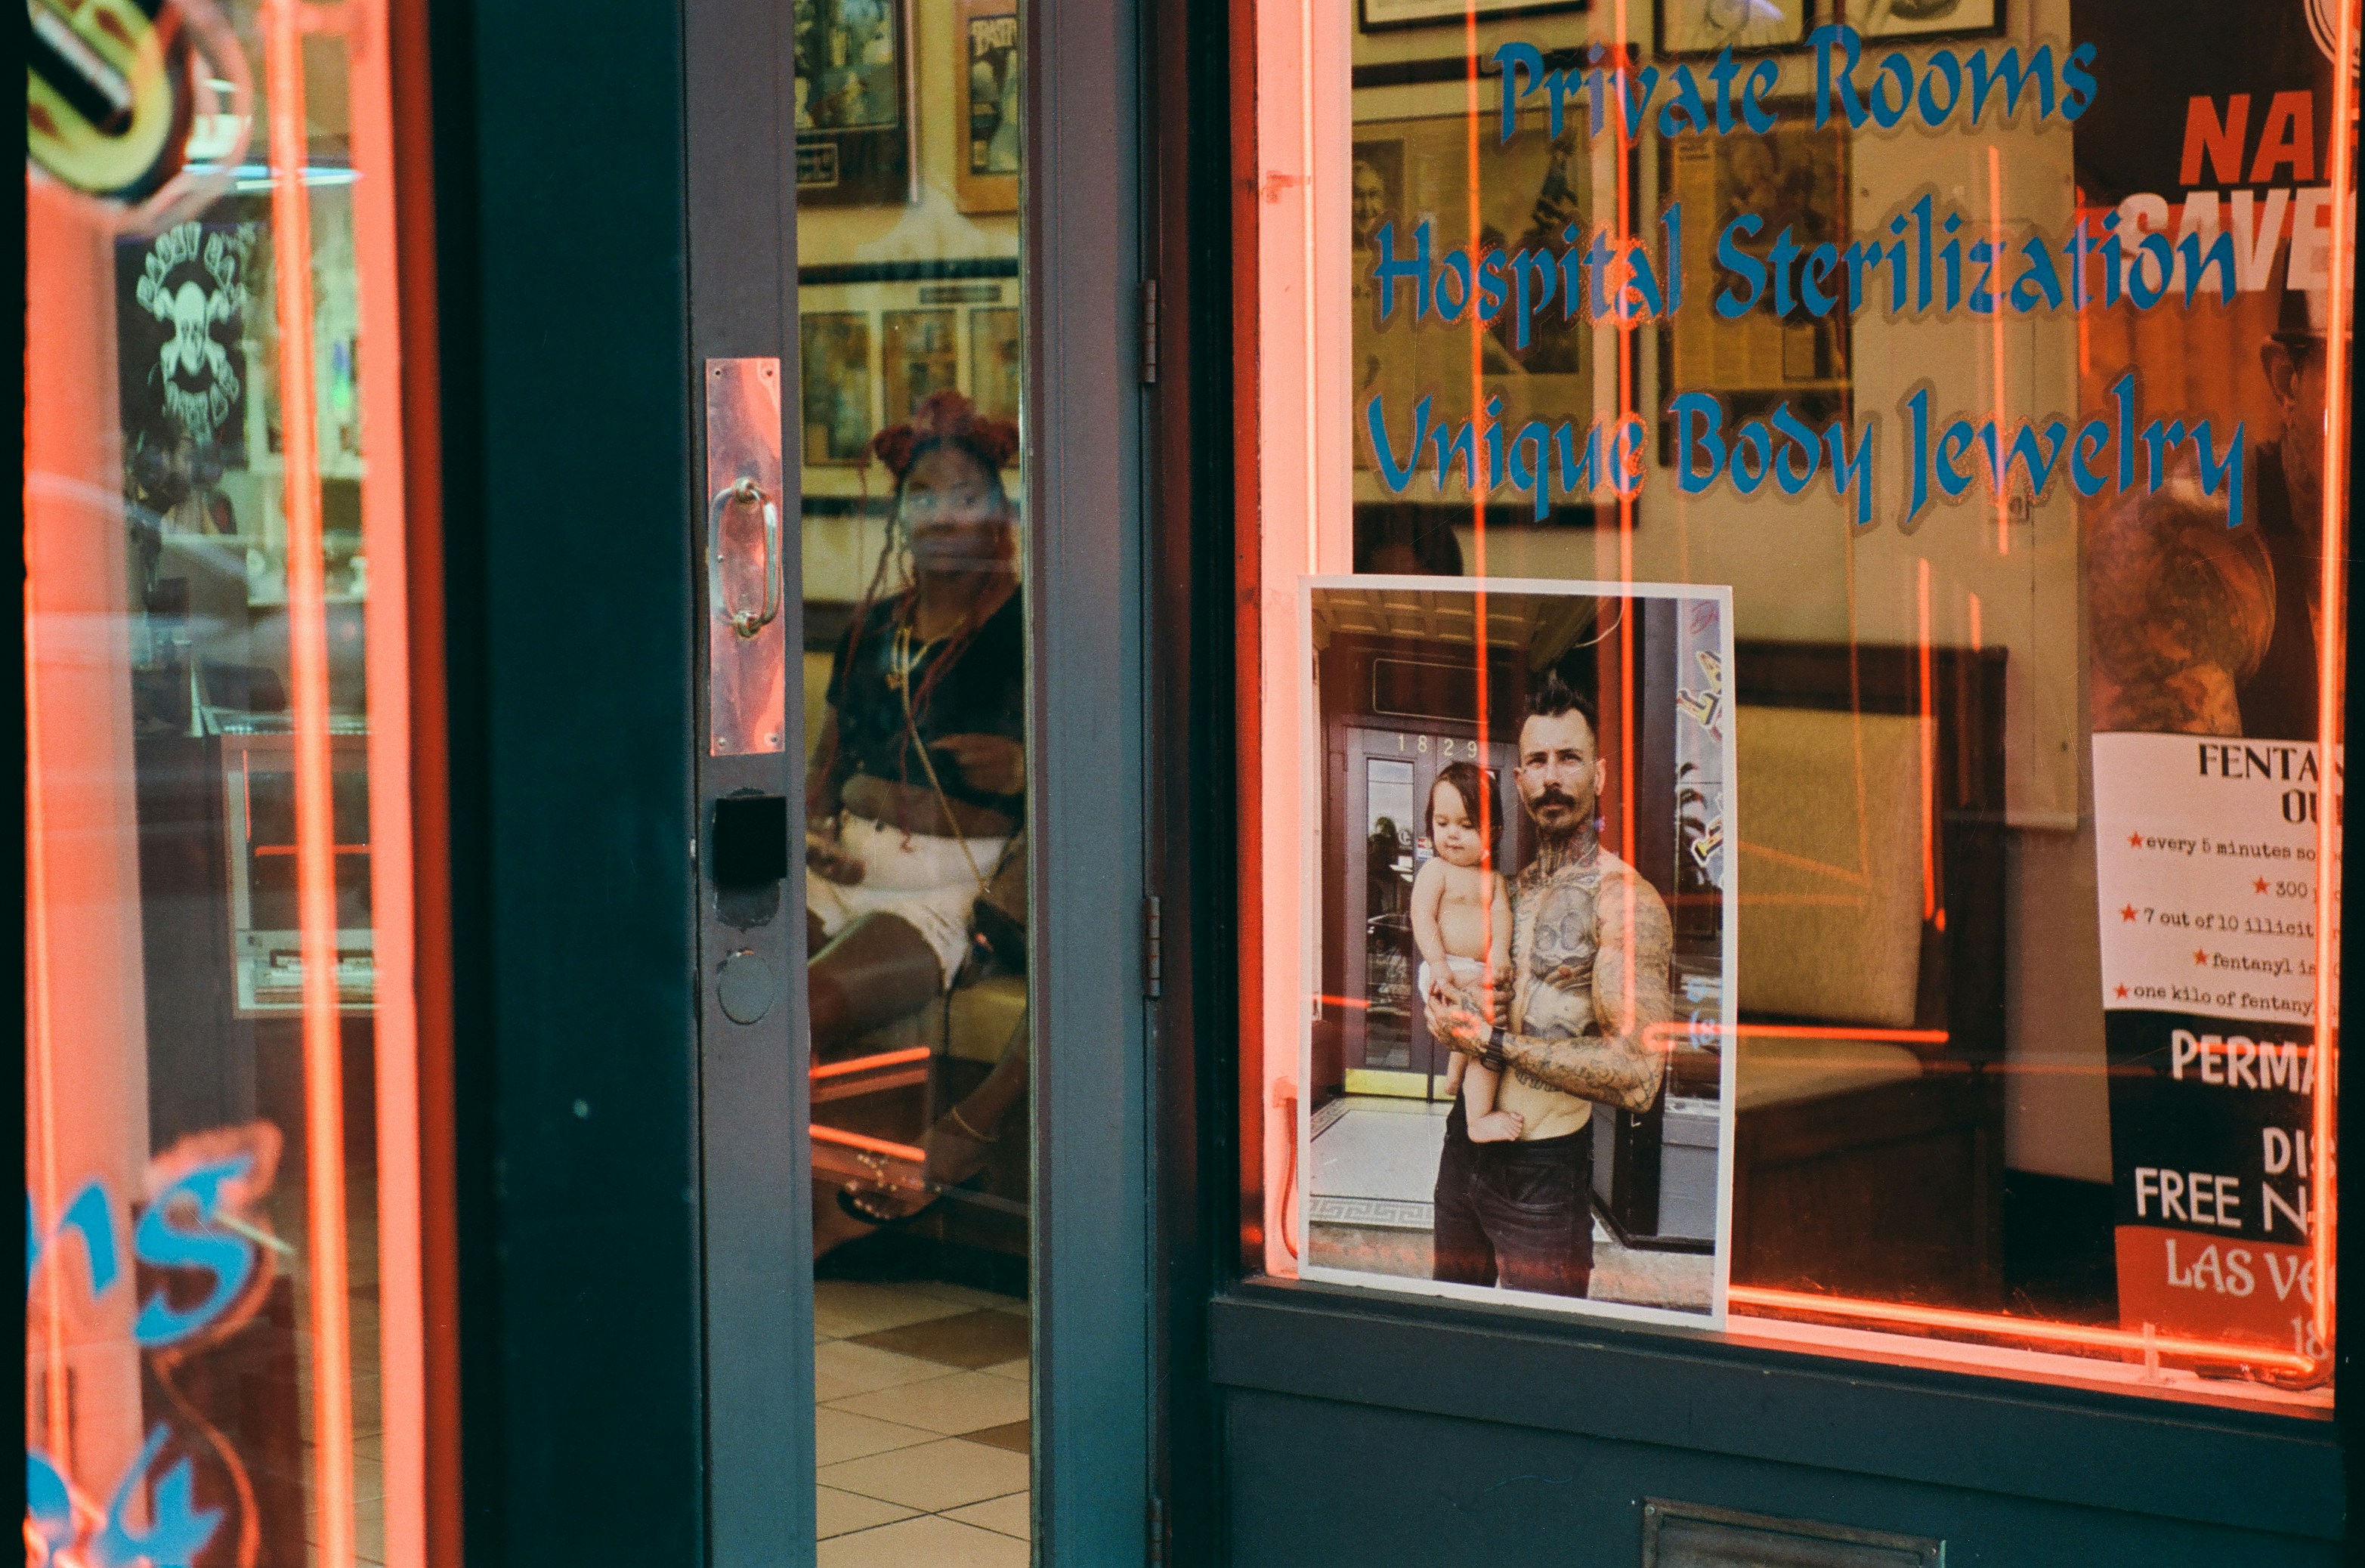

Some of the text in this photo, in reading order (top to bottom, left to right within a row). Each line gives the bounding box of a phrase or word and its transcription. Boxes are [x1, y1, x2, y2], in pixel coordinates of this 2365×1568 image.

[1493, 24, 2098, 144] Private Rooms
[2179, 89, 2358, 185] NA
[2116, 187, 2357, 293] SAVE
[1373, 193, 2237, 350] Hospital Sterilization
[1367, 373, 2244, 528] Unique Body Jewelry
[1398, 733, 1478, 759] 1829
[2199, 744, 2343, 782] FENTA
[2147, 837, 2196, 855] every
[2217, 840, 2291, 858] minutes
[2276, 881, 2308, 898] 300
[2144, 908, 2314, 938] 7 out of 10 illicit
[2212, 952, 2292, 976] fentanyl
[2133, 984, 2317, 1017] one kilo of fentany
[2171, 1028, 2339, 1095] PERMA
[2135, 1166, 2242, 1229] FREE
[2166, 1238, 2255, 1297] LAS
